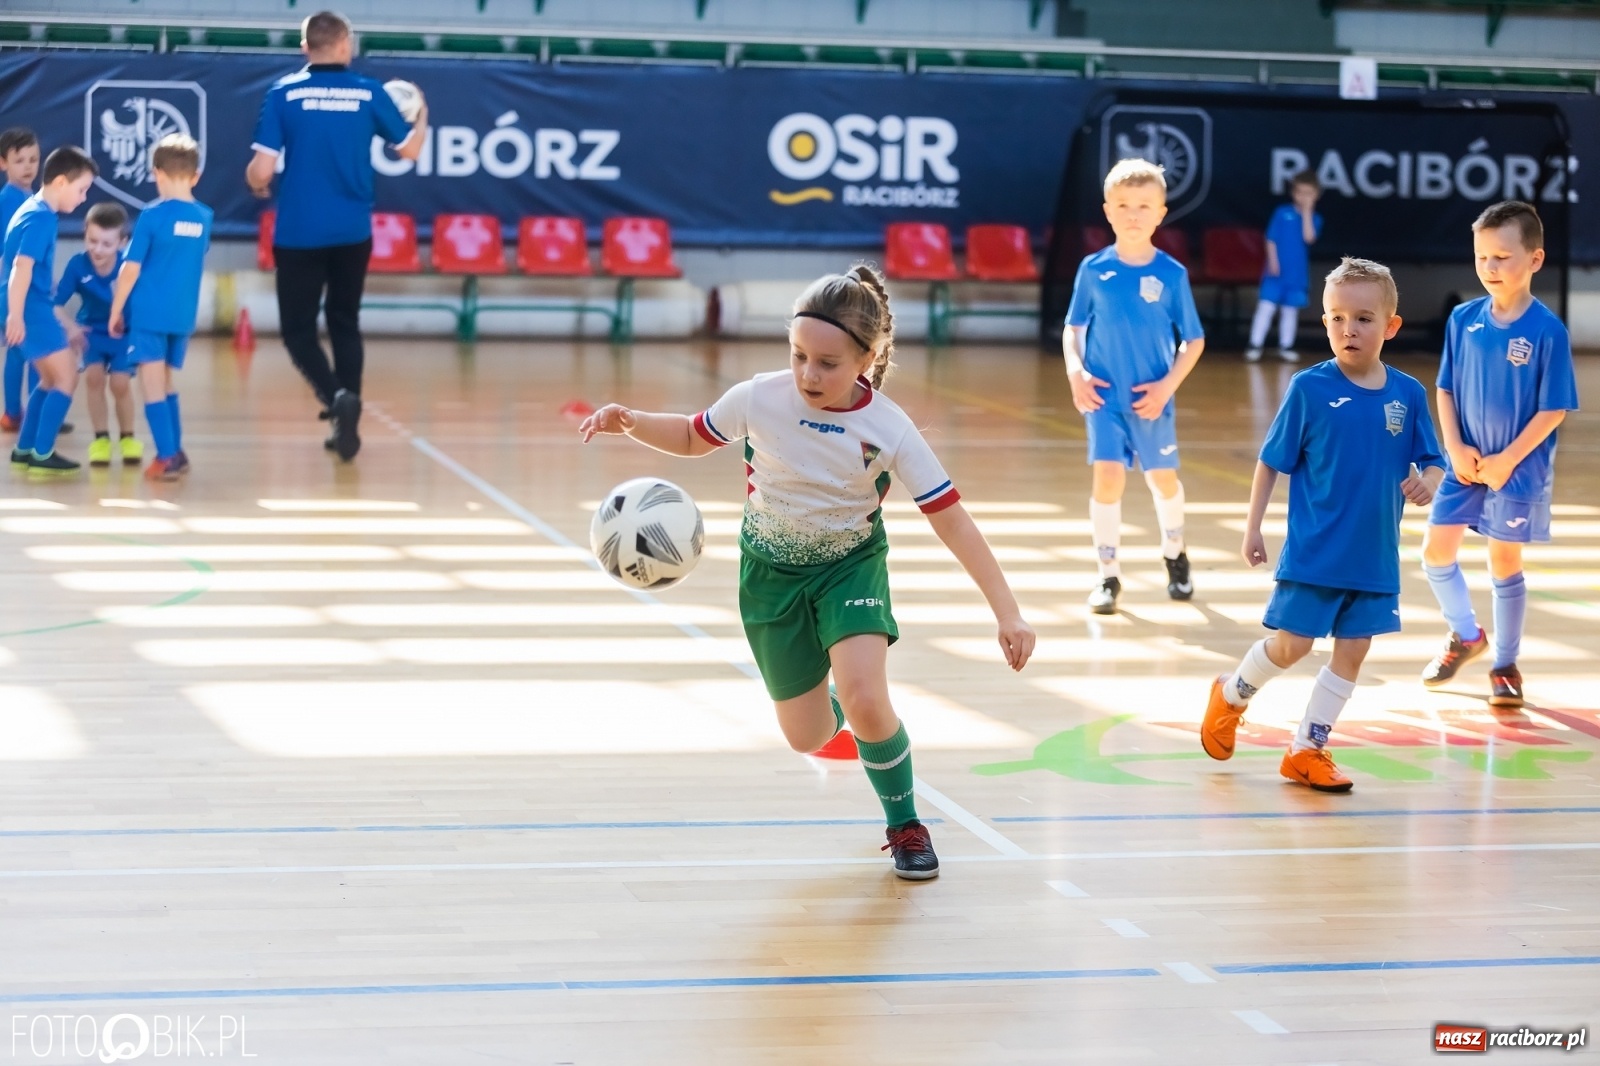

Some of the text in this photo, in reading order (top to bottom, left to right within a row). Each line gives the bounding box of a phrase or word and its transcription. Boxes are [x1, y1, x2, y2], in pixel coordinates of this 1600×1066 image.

[370, 110, 621, 181] CIBÓRZ
[843, 182, 960, 208] RACIBÓRZ
[799, 419, 846, 434] regio
